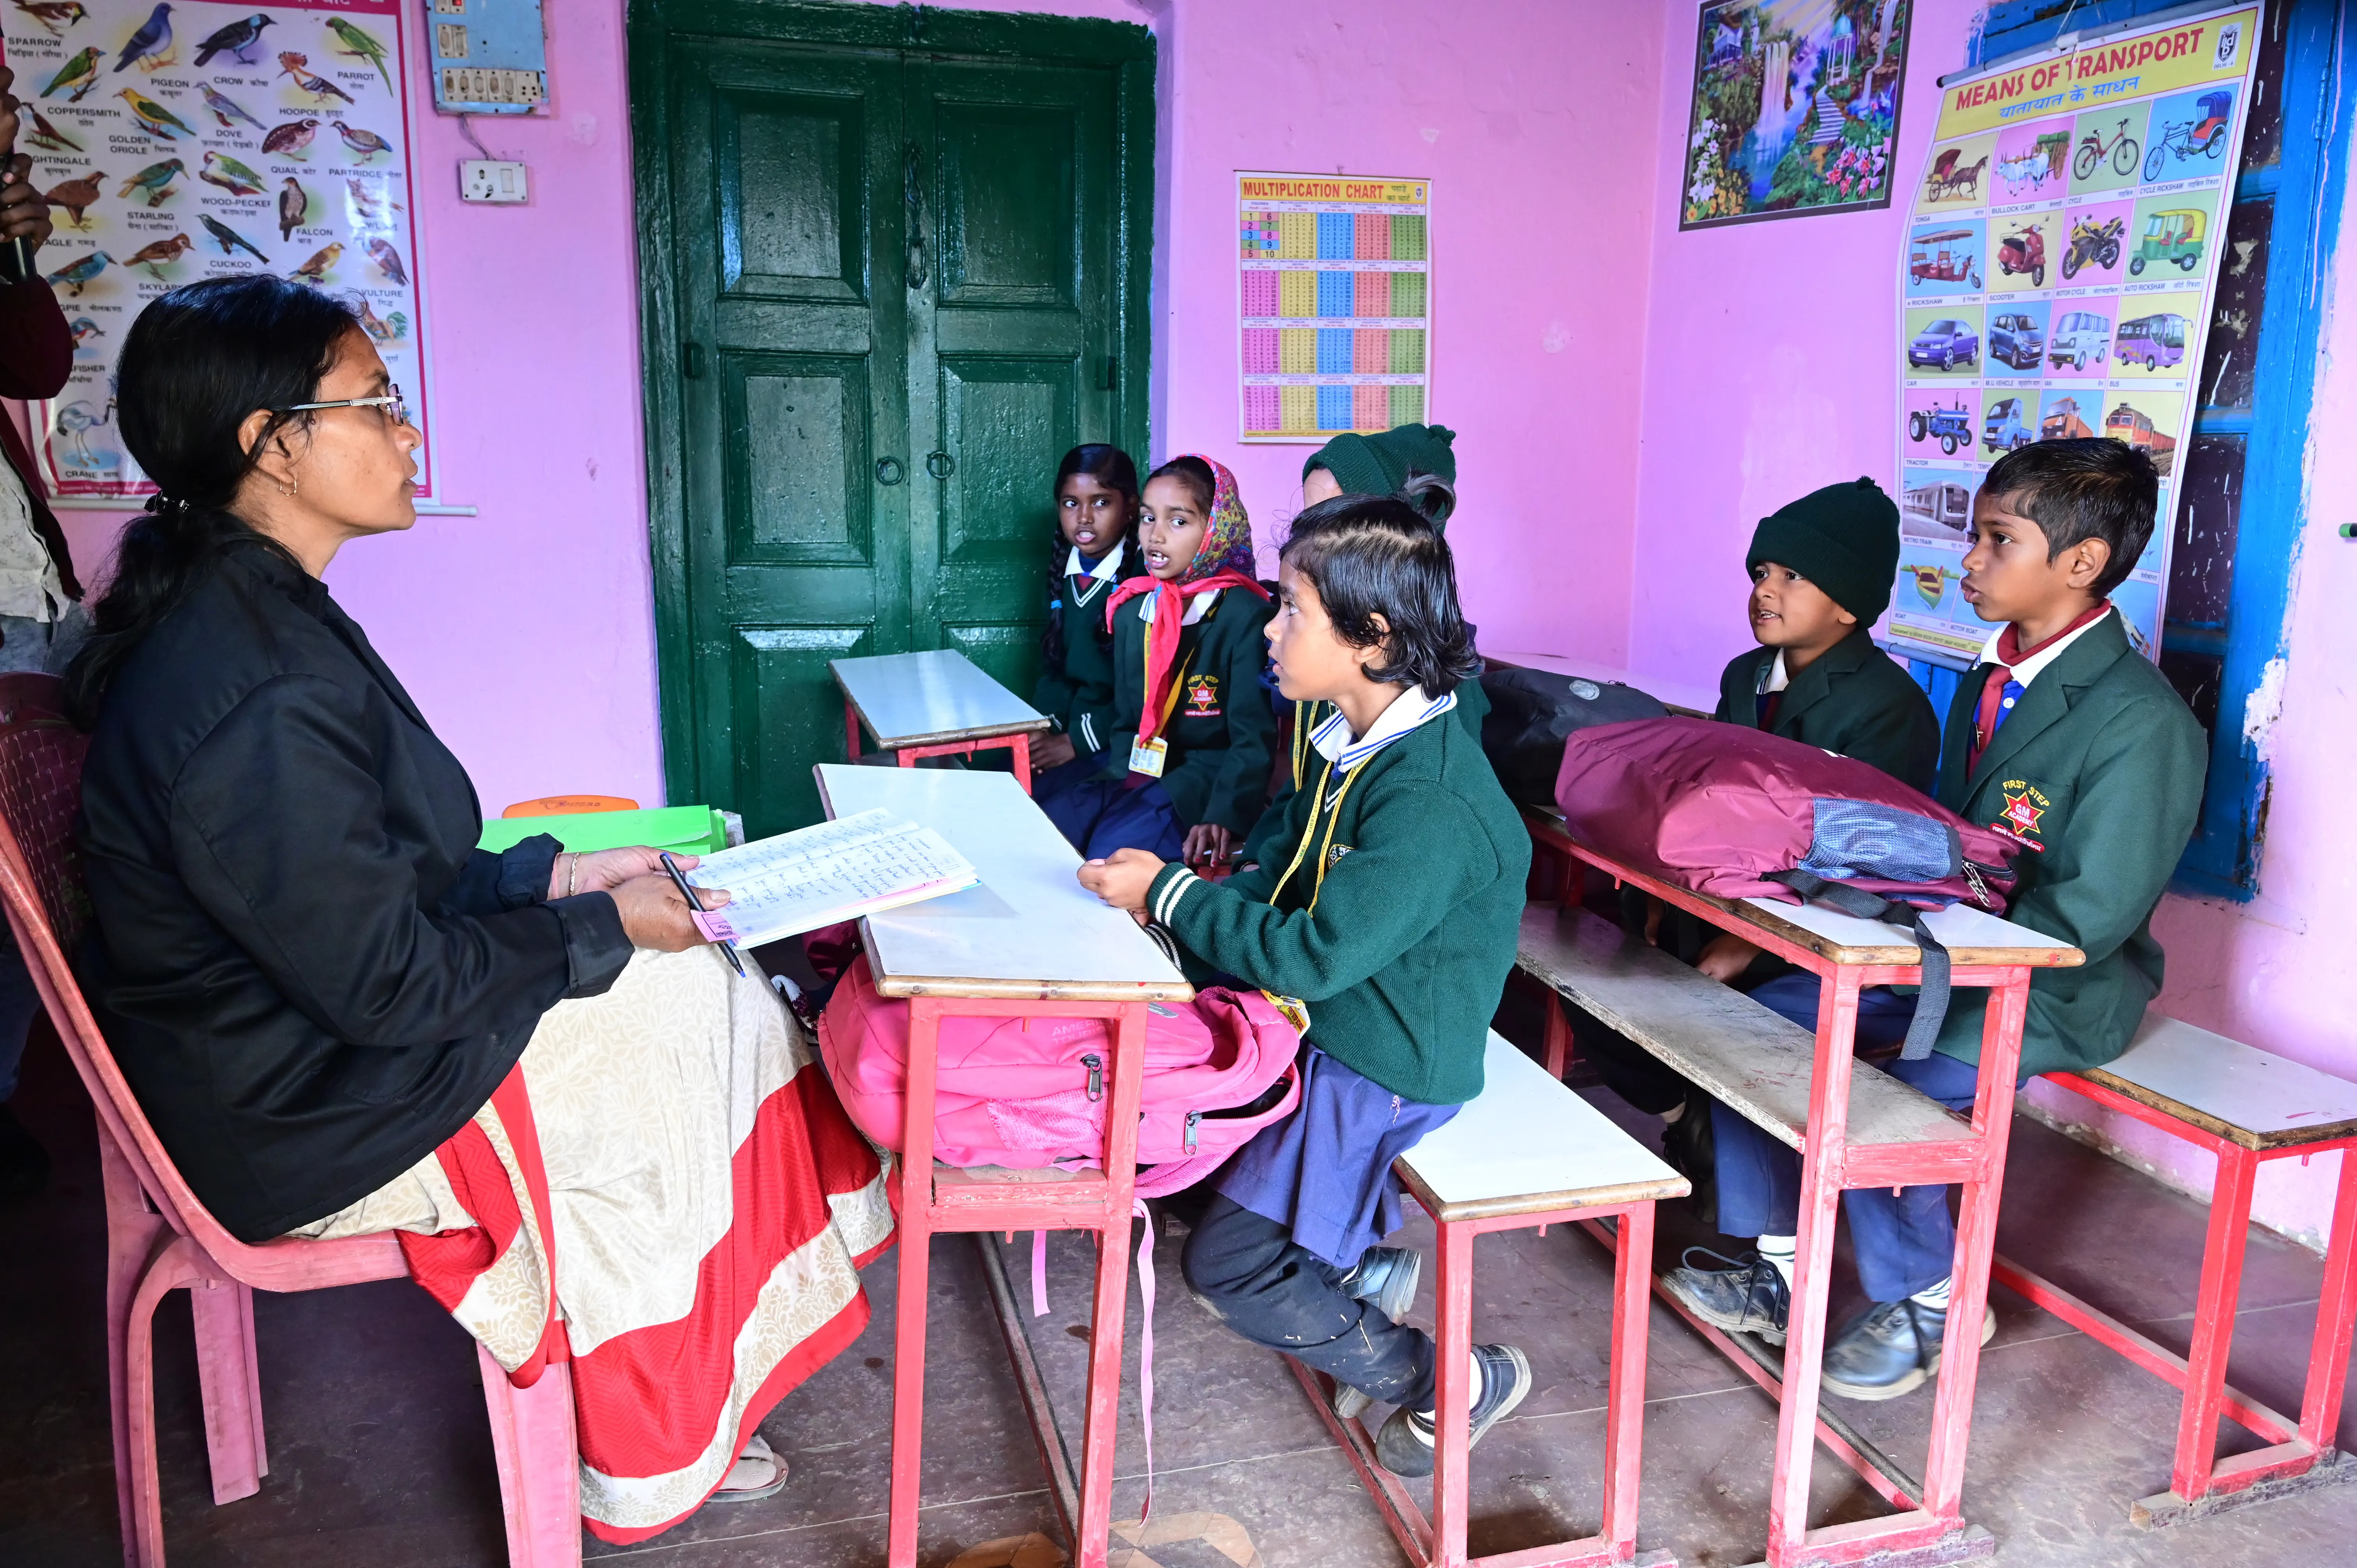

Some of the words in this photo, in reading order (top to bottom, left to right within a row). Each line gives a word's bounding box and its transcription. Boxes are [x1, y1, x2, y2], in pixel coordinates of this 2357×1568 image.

[8, 37, 61, 47] SPARROW
[1956, 74, 2025, 110] MEANS
[2031, 64, 2060, 91] OF
[2066, 28, 2204, 81] TRANSPORT
[214, 76, 243, 85] CROW
[337, 71, 375, 81] PARROT
[150, 78, 189, 88] PIGEON
[2000, 93, 2063, 118] यातायात
[2069, 85, 2087, 102] के
[2093, 76, 2140, 98] साधन
[47, 106, 121, 118] COPPERSMITH
[279, 108, 320, 117] HOOPOE
[216, 129, 243, 138] DOVE
[109, 135, 151, 144] GOLDEN
[110, 145, 148, 155] ORIOLE
[32, 155, 92, 166] GHTINGALE
[270, 166, 299, 175] QUAIL
[329, 168, 382, 178] PARTRIDGE
[1244, 182, 1340, 198] MULTIPLICATION
[1346, 184, 1384, 199] CHART
[2140, 185, 2156, 194] CYCLE
[2157, 182, 2184, 192] RICKSHAW
[2068, 196, 2082, 205] CYCLE
[1991, 206, 2019, 214] BULLOCK
[127, 211, 175, 221] STARLING
[296, 228, 333, 236] FALCON
[45, 238, 72, 247] AGLE
[210, 260, 252, 268] CUCKOO
[2138, 283, 2166, 291] RICKSHAW
[361, 289, 403, 298] VULTURE
[2056, 288, 2071, 297] MOTOR
[2071, 288, 2085, 296] CYCLE
[1187, 675, 1203, 685] FIRST
[1205, 675, 1219, 683] STEP
[2002, 780, 2026, 790] FIRST
[2028, 786, 2050, 807] STEP
[2015, 803, 2030, 818] GM
[2008, 810, 2034, 827] ACADEMY
[1295, 844, 1307, 866] DUMKA
